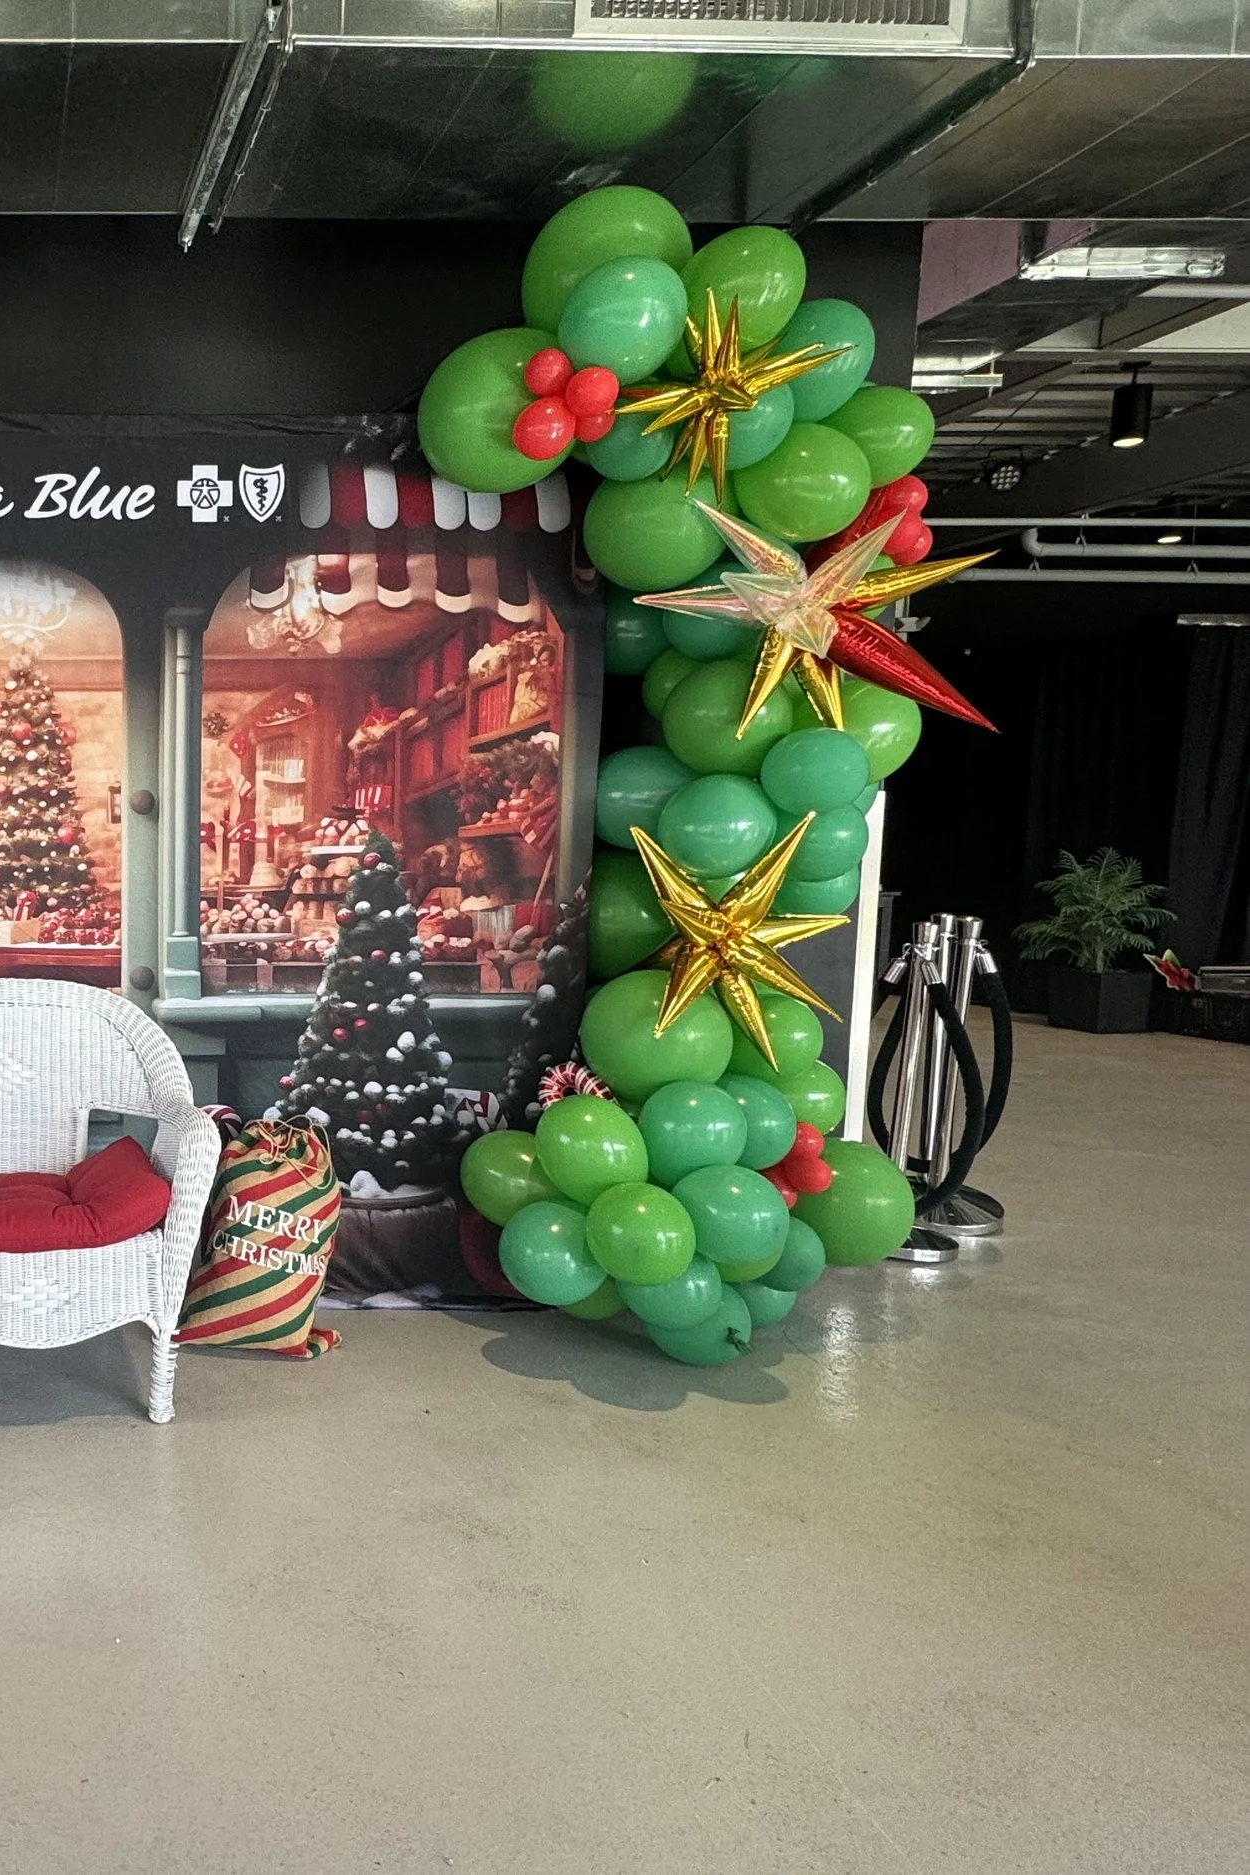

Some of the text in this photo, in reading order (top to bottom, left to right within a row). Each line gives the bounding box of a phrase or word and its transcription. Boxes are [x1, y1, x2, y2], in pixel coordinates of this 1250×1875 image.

[24, 466, 155, 519] Blue
[226, 1195, 327, 1244] MERRY
[212, 1229, 327, 1276] CHRISTMAS
